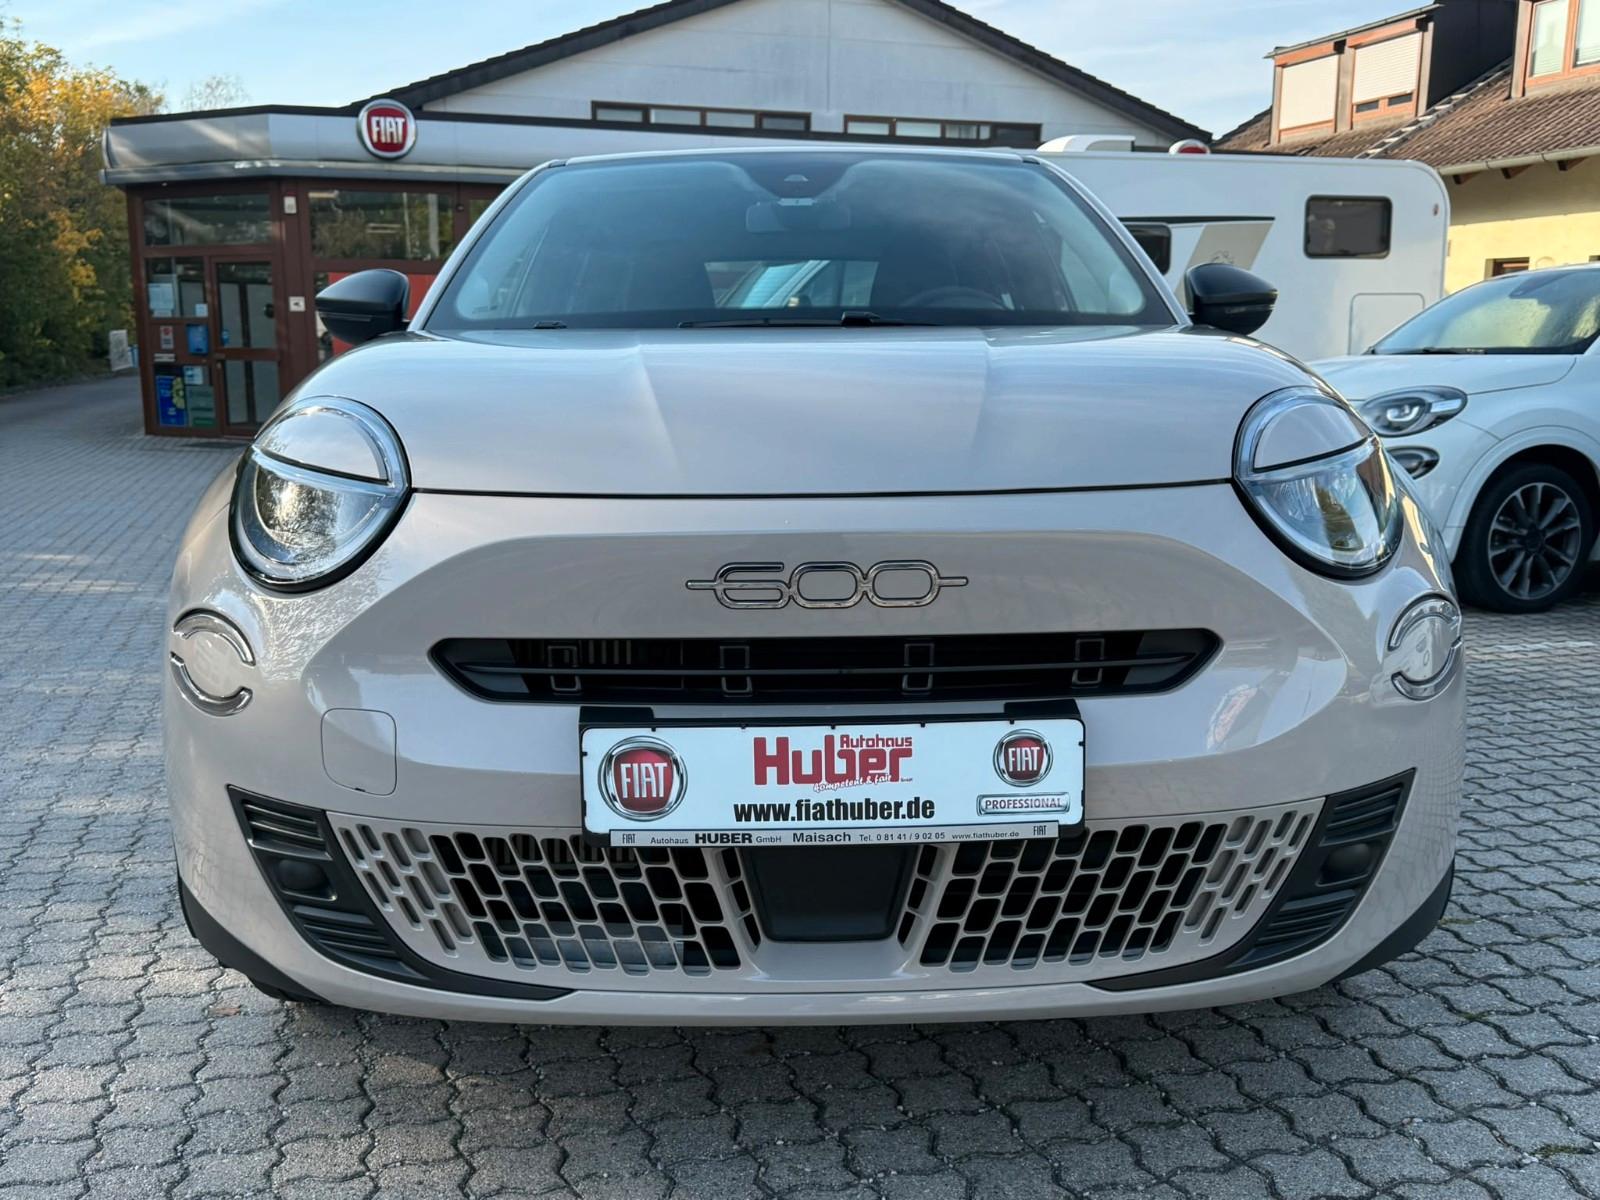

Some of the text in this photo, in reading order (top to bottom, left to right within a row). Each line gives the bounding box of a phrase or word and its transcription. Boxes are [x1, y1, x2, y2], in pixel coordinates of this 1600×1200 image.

[371, 116, 406, 144] FIAT
[714, 559, 941, 609] 600
[840, 734, 913, 748] Autohaus
[753, 734, 913, 786] Huber
[1008, 746, 1040, 772] FIAT
[620, 762, 668, 799] FIAT
[813, 776, 863, 793] kompetent
[866, 775, 873, 785] &
[874, 772, 893, 785] fair
[733, 797, 936, 822] www.fiathuber.de
[984, 797, 1064, 810] PROFESSIONAL
[622, 833, 636, 844] FIAT
[651, 836, 689, 844] Autohaus
[695, 833, 753, 844] HUBER
[755, 835, 782, 844] GmbH
[792, 831, 851, 843] Maisach
[884, 833, 894, 841] 81
[897, 833, 907, 841] 41
[934, 832, 945, 840] 05
[951, 830, 1020, 840] www.fiathuber.de
[1033, 825, 1047, 836] FIAT
